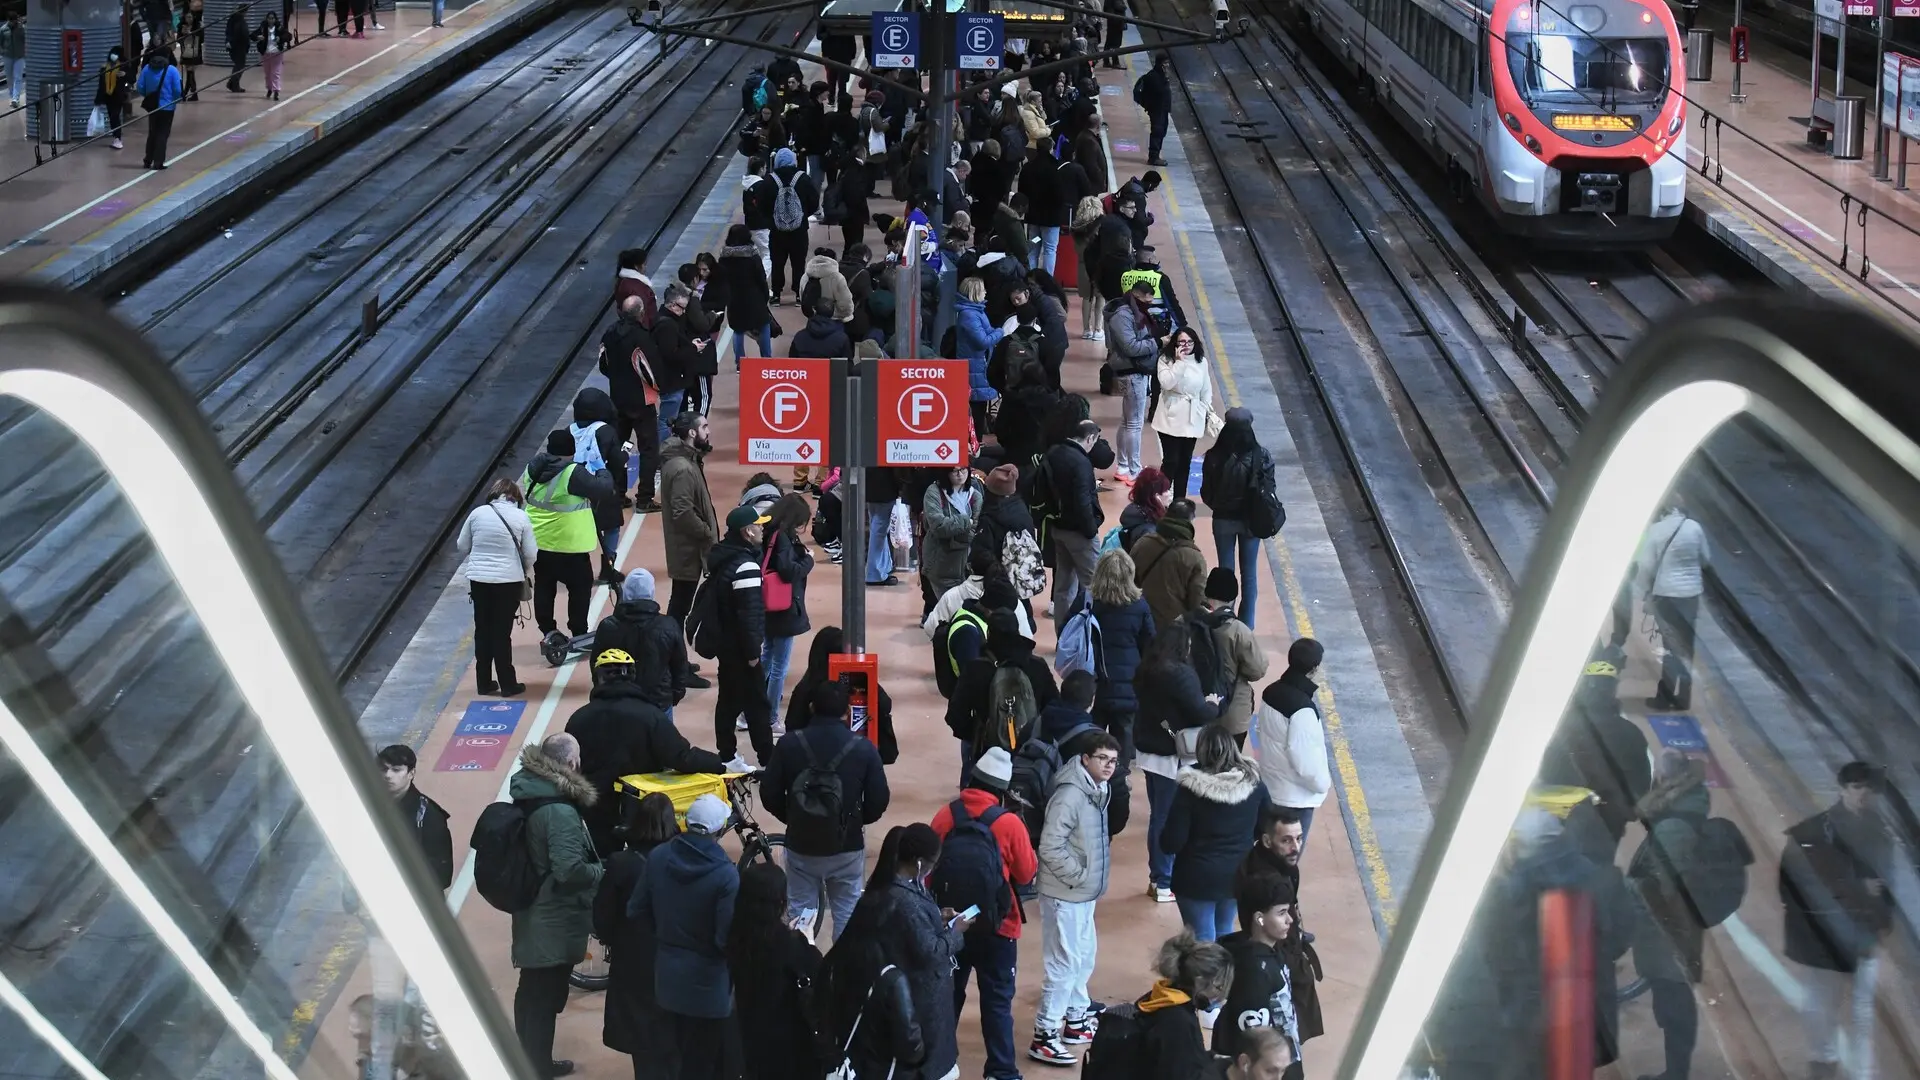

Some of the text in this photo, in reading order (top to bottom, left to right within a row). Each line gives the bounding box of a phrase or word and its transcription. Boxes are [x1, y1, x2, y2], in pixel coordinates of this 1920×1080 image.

[889, 28, 902, 48] E
[973, 30, 986, 49] E
[903, 56, 909, 64] 4
[761, 369, 808, 380] SECTOR
[901, 368, 945, 379] SECTOR
[774, 391, 799, 425] F
[911, 392, 934, 426] F
[755, 440, 770, 449] Vía
[893, 441, 908, 450] Vía
[754, 451, 792, 462] Platform
[801, 445, 809, 457] 4
[939, 446, 948, 457] 3
[892, 452, 930, 462] Platform
